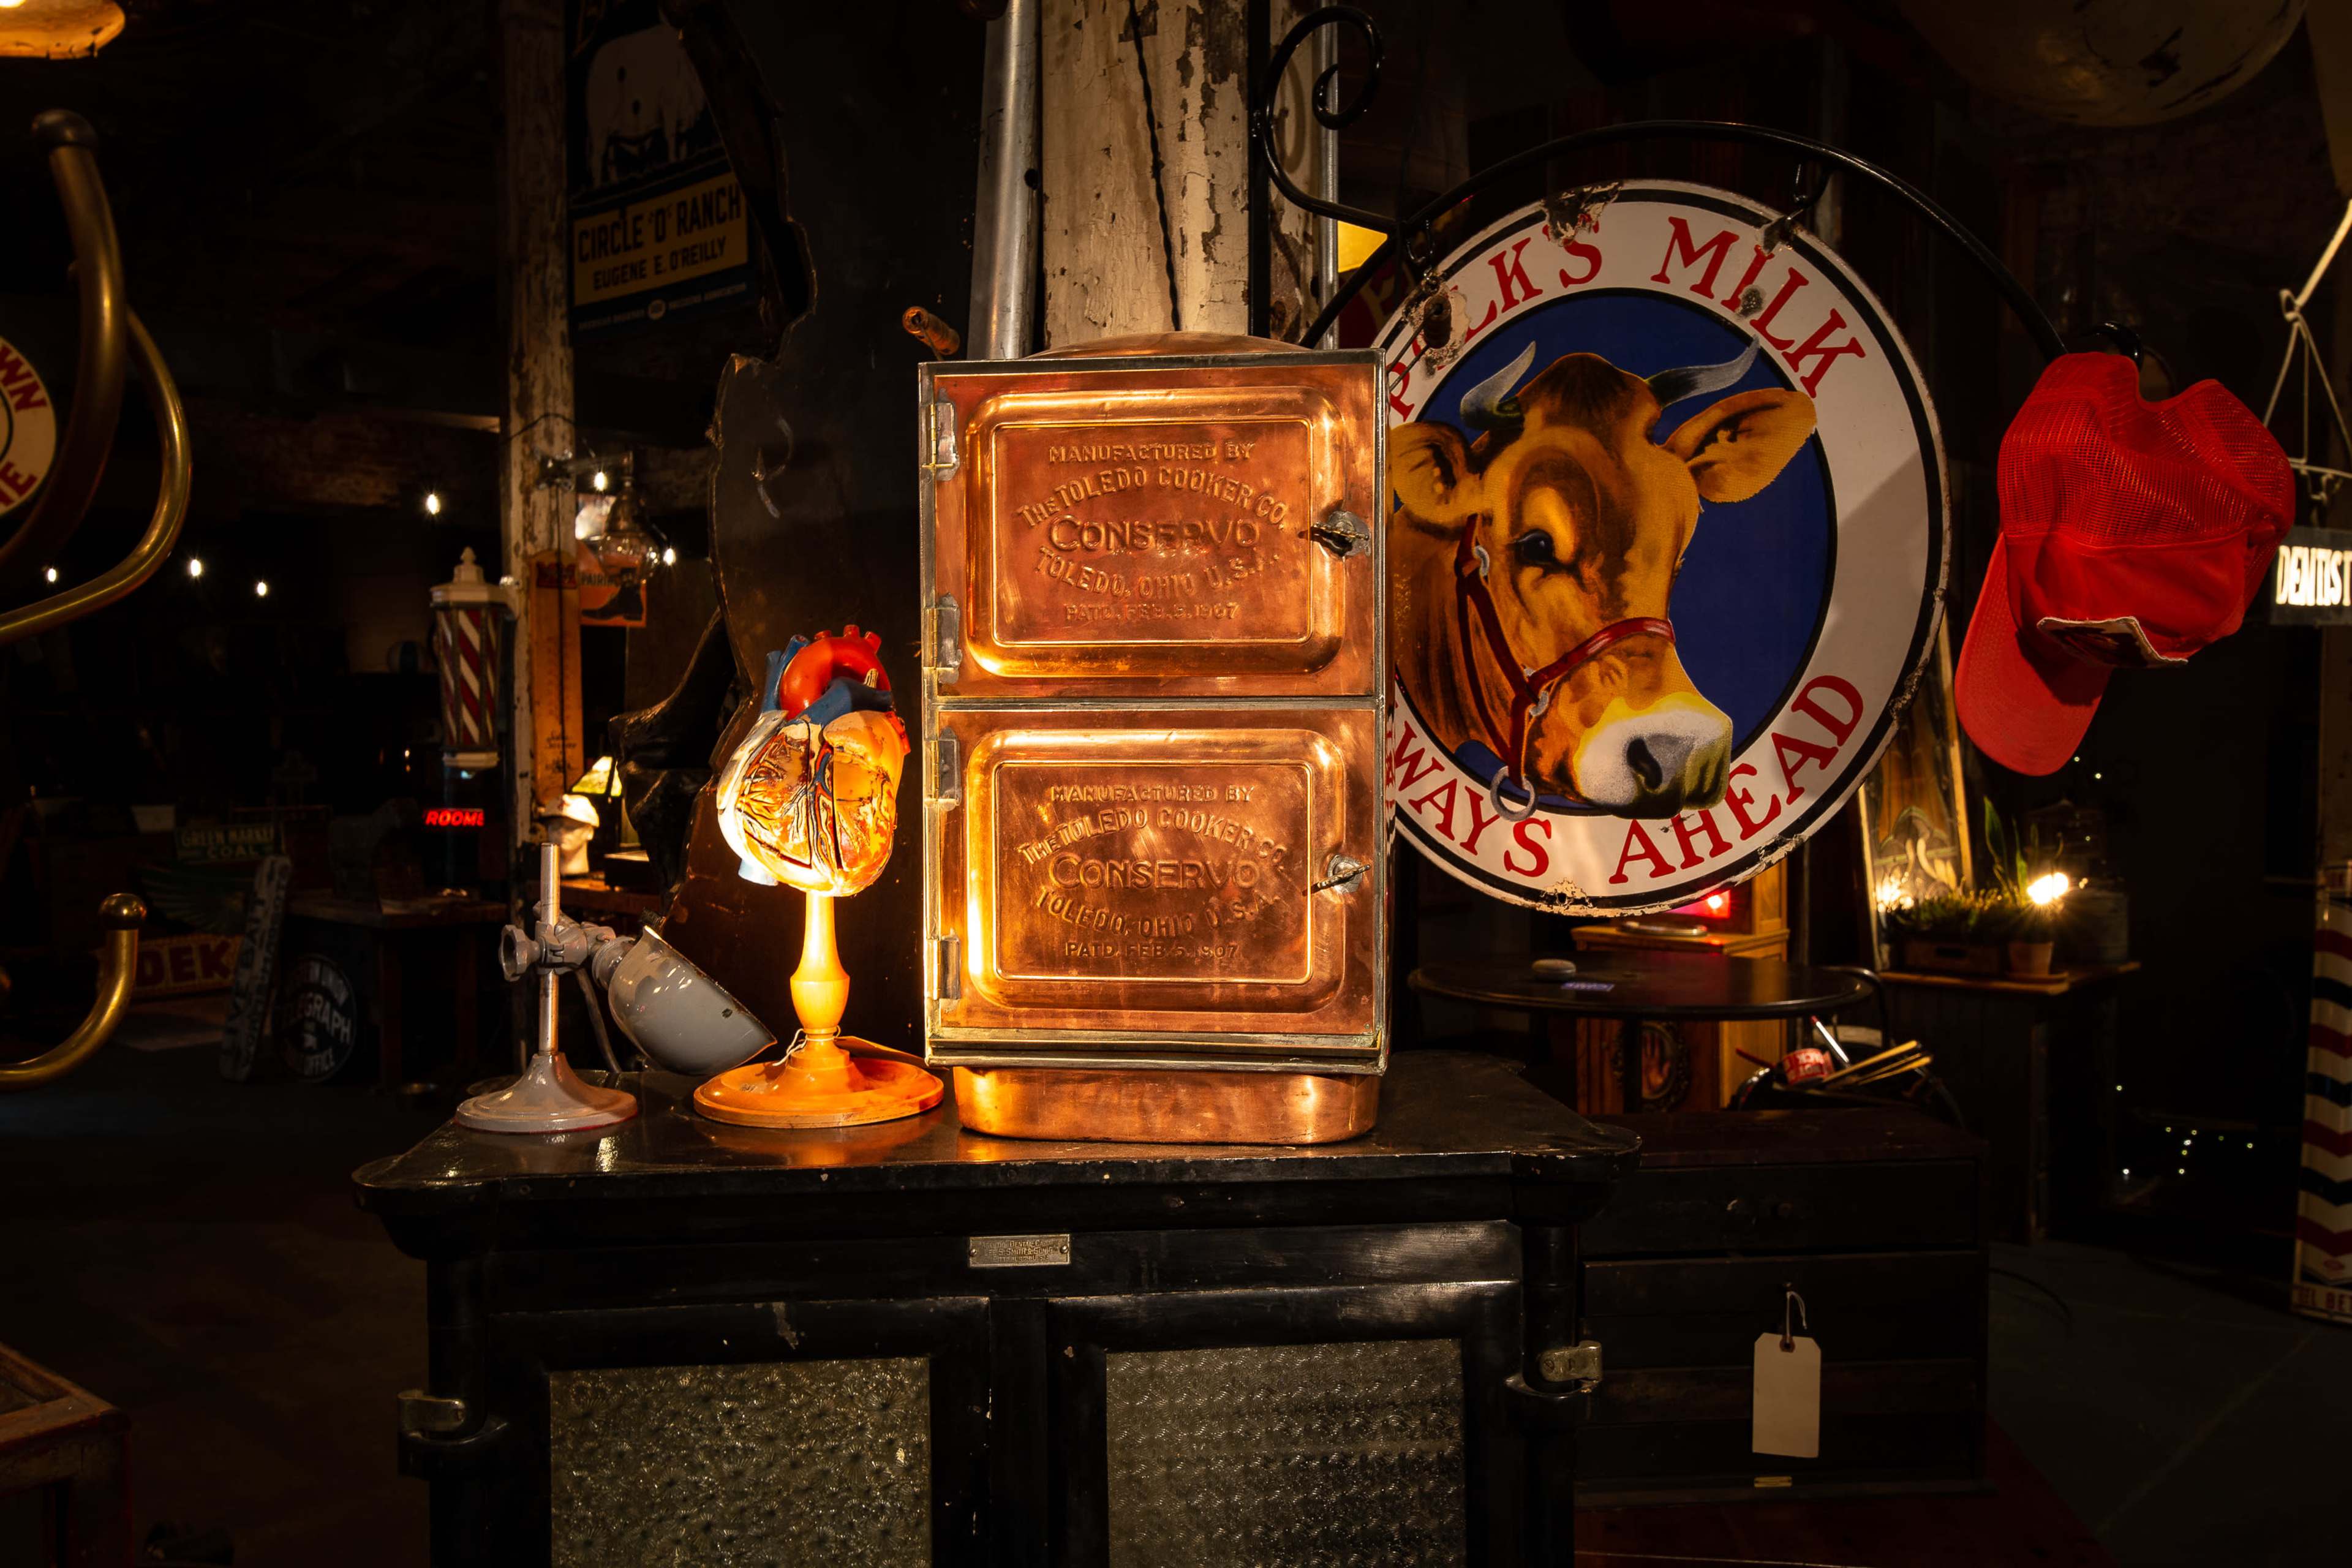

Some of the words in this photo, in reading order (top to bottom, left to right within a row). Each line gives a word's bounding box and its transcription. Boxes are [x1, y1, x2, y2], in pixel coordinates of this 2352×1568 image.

[579, 210, 643, 264] CIRCLE
[677, 185, 740, 236] RANCH
[592, 256, 647, 291] EUGENE
[670, 236, 726, 270] O'REILLY
[1651, 216, 1867, 398] MILK
[1049, 442, 1217, 464] MANUFACTURED
[1226, 441, 1256, 460] BY
[1017, 497, 1060, 529] THE
[1055, 466, 1148, 507] TOLEDO
[1158, 466, 1254, 510] COOKER
[1257, 494, 1287, 531] CO.
[1048, 514, 1261, 552] CONSERVO
[1138, 572, 1197, 599] OHIO
[1050, 785, 1216, 804] MANUFACTURED
[1225, 785, 1256, 804] BY
[1608, 674, 1864, 884] AHEAD
[1017, 837, 1060, 865] THE
[1058, 807, 1148, 845] TOLEDO
[1156, 807, 1254, 850] COOKER
[1047, 851, 1264, 891] CONSERVO
[1137, 914, 1195, 938] OHIO
